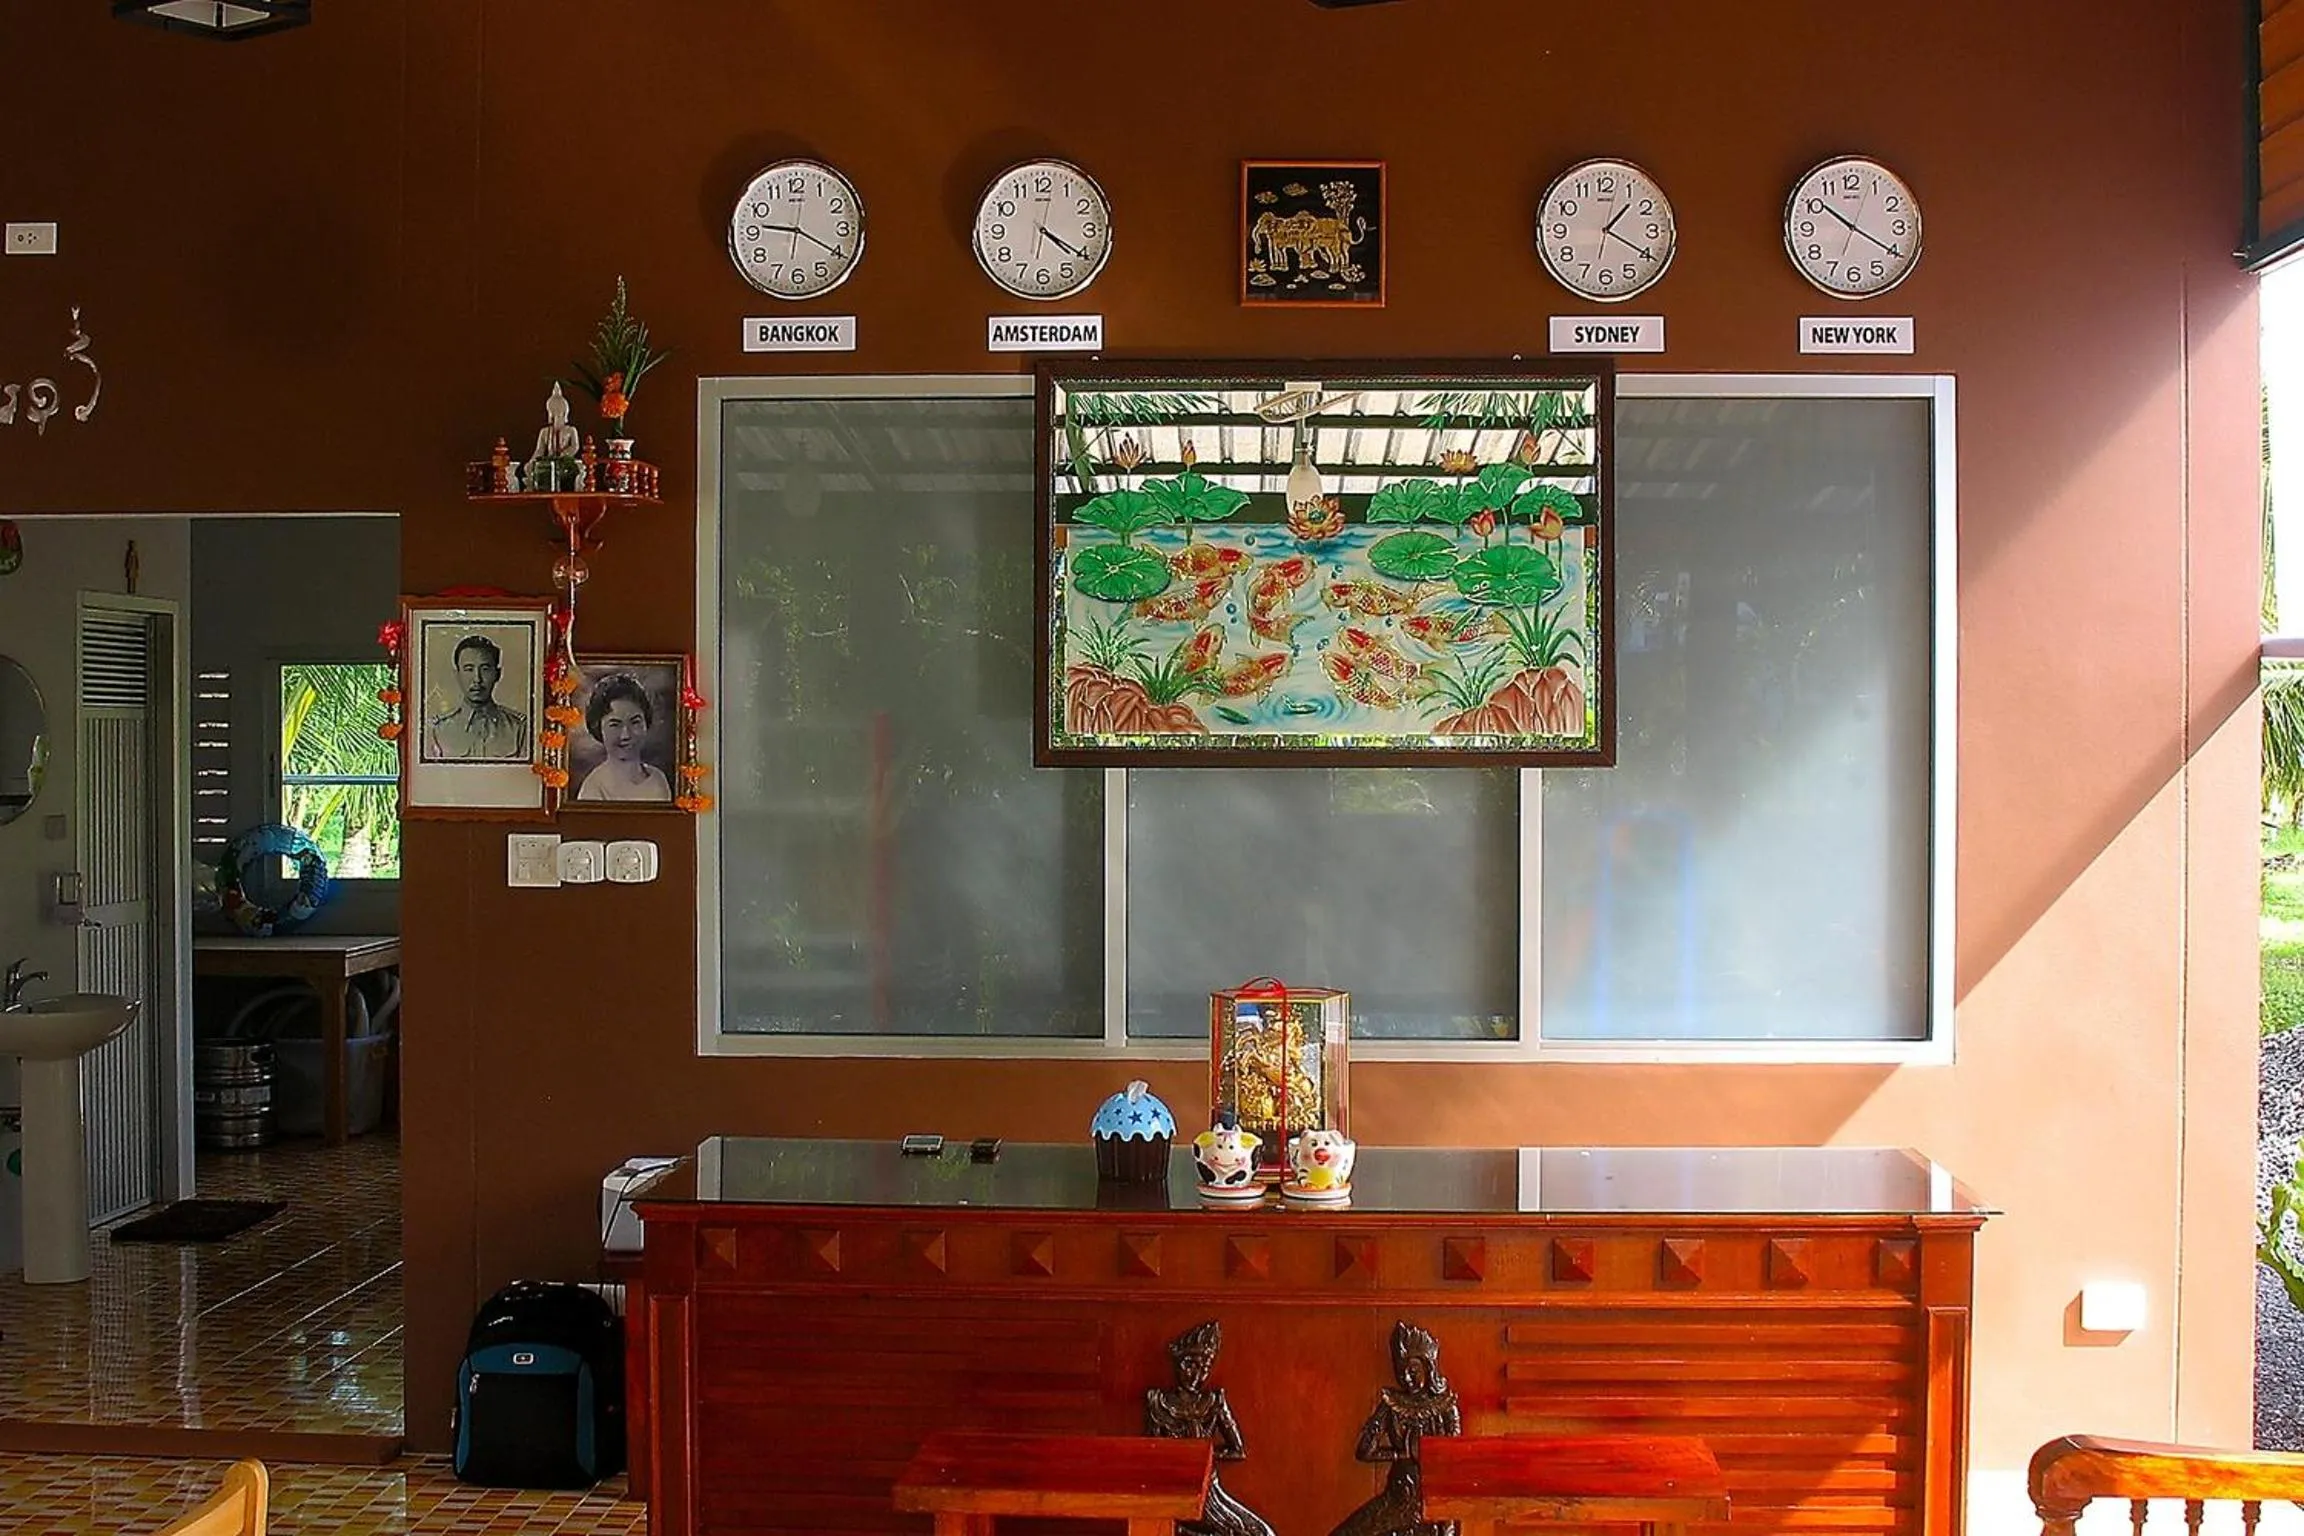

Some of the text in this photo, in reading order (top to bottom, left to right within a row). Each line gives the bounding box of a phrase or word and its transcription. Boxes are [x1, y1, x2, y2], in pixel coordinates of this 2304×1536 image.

[788, 178, 804, 194] 12
[1035, 177, 1051, 193] 12
[1576, 183, 1588, 197] 11
[1597, 177, 1613, 193] 12
[1822, 181, 1834, 195] 11
[1842, 175, 1859, 190] 12
[768, 184, 780, 199] 11
[1014, 184, 1026, 198] 11
[752, 202, 769, 218] 10
[830, 198, 842, 213] 2
[997, 201, 1015, 217] 10
[1077, 199, 1089, 214] 2
[1559, 200, 1577, 216] 10
[1639, 200, 1652, 215] 2
[1806, 198, 1823, 214] 10
[1886, 196, 1898, 212] 2
[746, 226, 760, 241] 9
[837, 221, 849, 237] 3
[991, 224, 1005, 240] 9
[1083, 222, 1096, 238] 3
[1553, 223, 1567, 239] 9
[1646, 223, 1659, 239] 3
[1800, 221, 1814, 237] 9
[1892, 220, 1905, 235] 3
[754, 248, 766, 263] 8
[831, 245, 843, 259] 4
[998, 247, 1011, 262] 8
[1077, 245, 1089, 260] 4
[1560, 246, 1573, 262] 8
[1639, 247, 1651, 261] 4
[1808, 244, 1821, 260] 8
[1887, 243, 1899, 258] 4
[771, 264, 783, 279] 7
[815, 262, 827, 277] 5
[1016, 263, 1027, 279] 7
[1060, 263, 1073, 278] 5
[1579, 264, 1590, 278] 7
[1623, 264, 1636, 279] 5
[1826, 261, 1838, 276] 7
[1847, 267, 1860, 282] 6
[1871, 260, 1883, 276] 5
[792, 269, 805, 284] 6
[1037, 269, 1050, 284] 6
[1599, 269, 1613, 285] 6
[759, 325, 839, 343] BANGKOK
[992, 325, 1099, 342] AMSTERDAM
[1574, 325, 1640, 344] SYDNEY
[1812, 326, 1897, 344] NEW YORK
